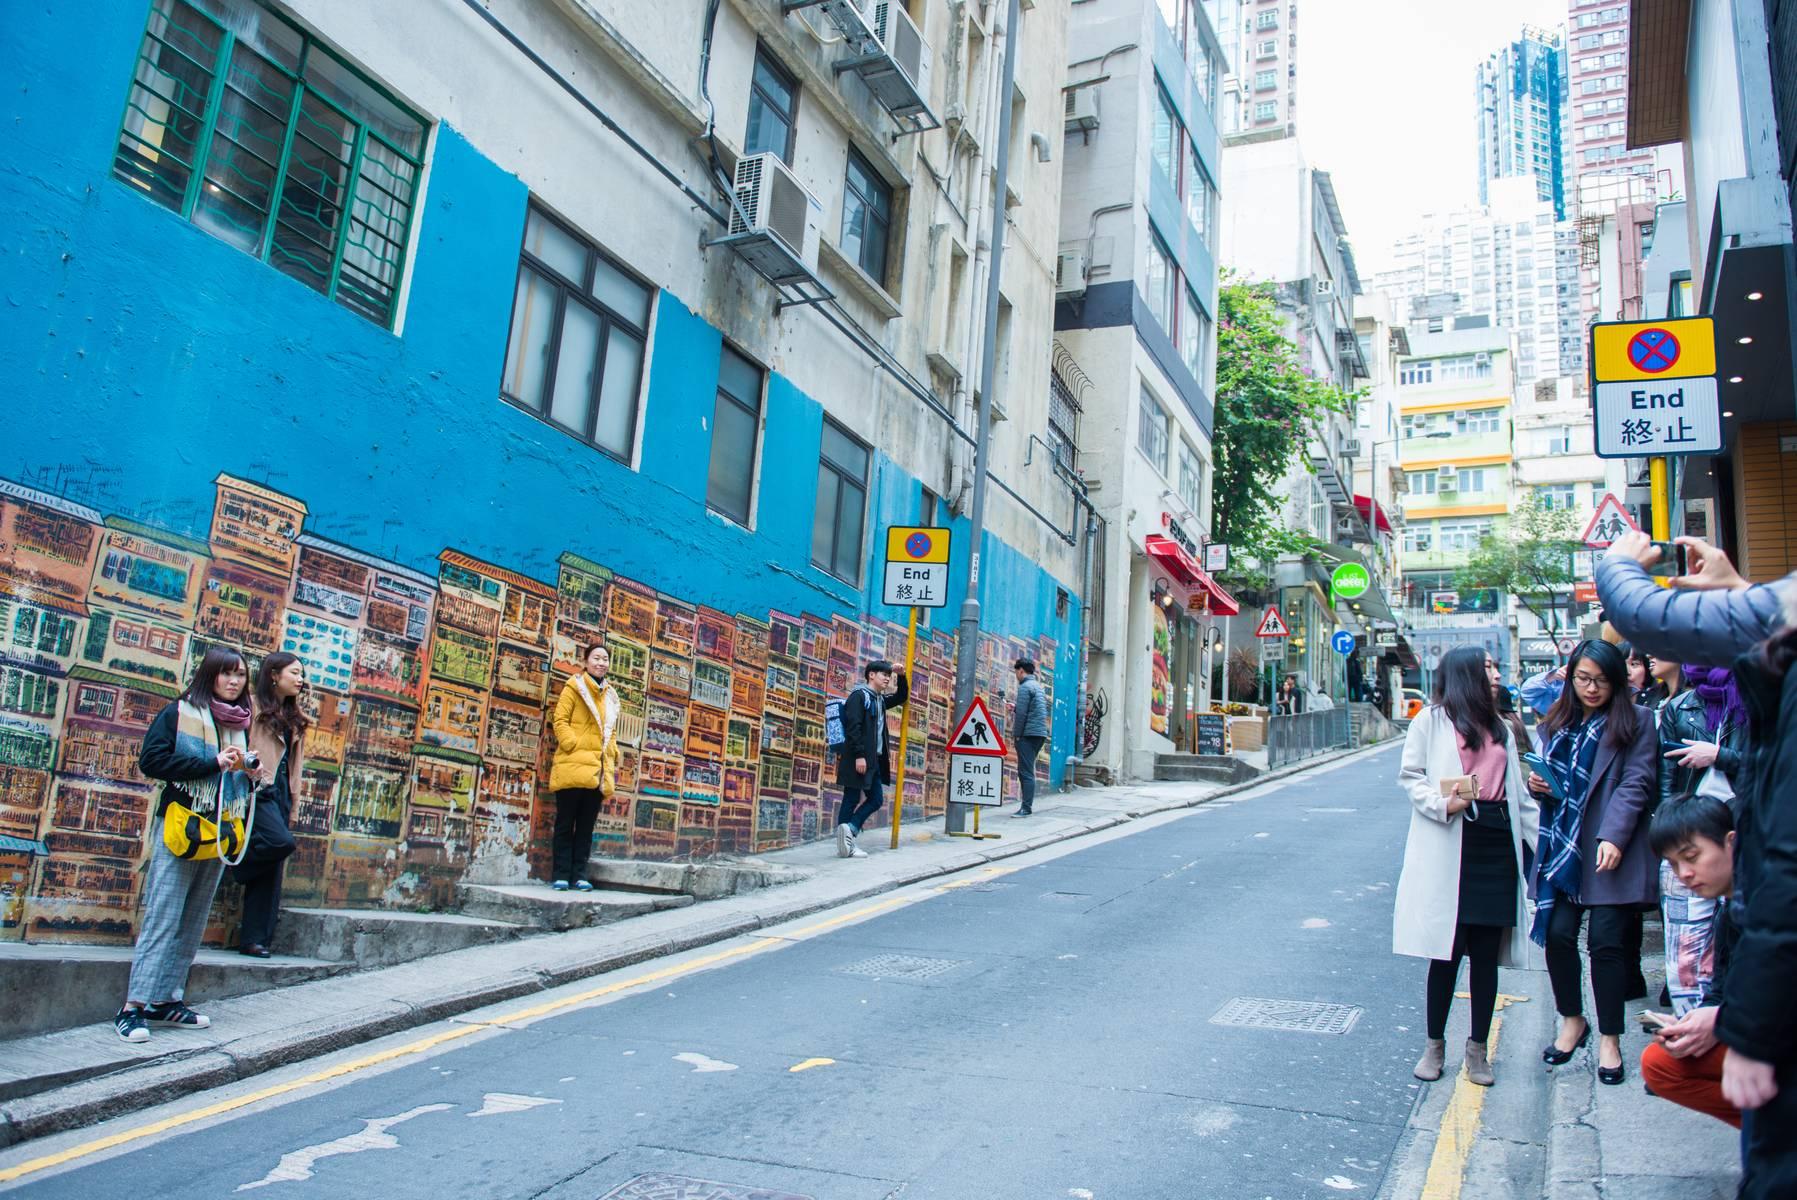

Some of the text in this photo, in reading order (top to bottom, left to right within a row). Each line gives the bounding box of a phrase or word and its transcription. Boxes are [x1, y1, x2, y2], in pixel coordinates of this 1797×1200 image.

[1631, 388, 1684, 409] End
[1621, 417, 1696, 446] 終止
[903, 567, 931, 580] End
[896, 583, 934, 601] 終止
[963, 761, 991, 775] End
[957, 778, 996, 798] 終止
